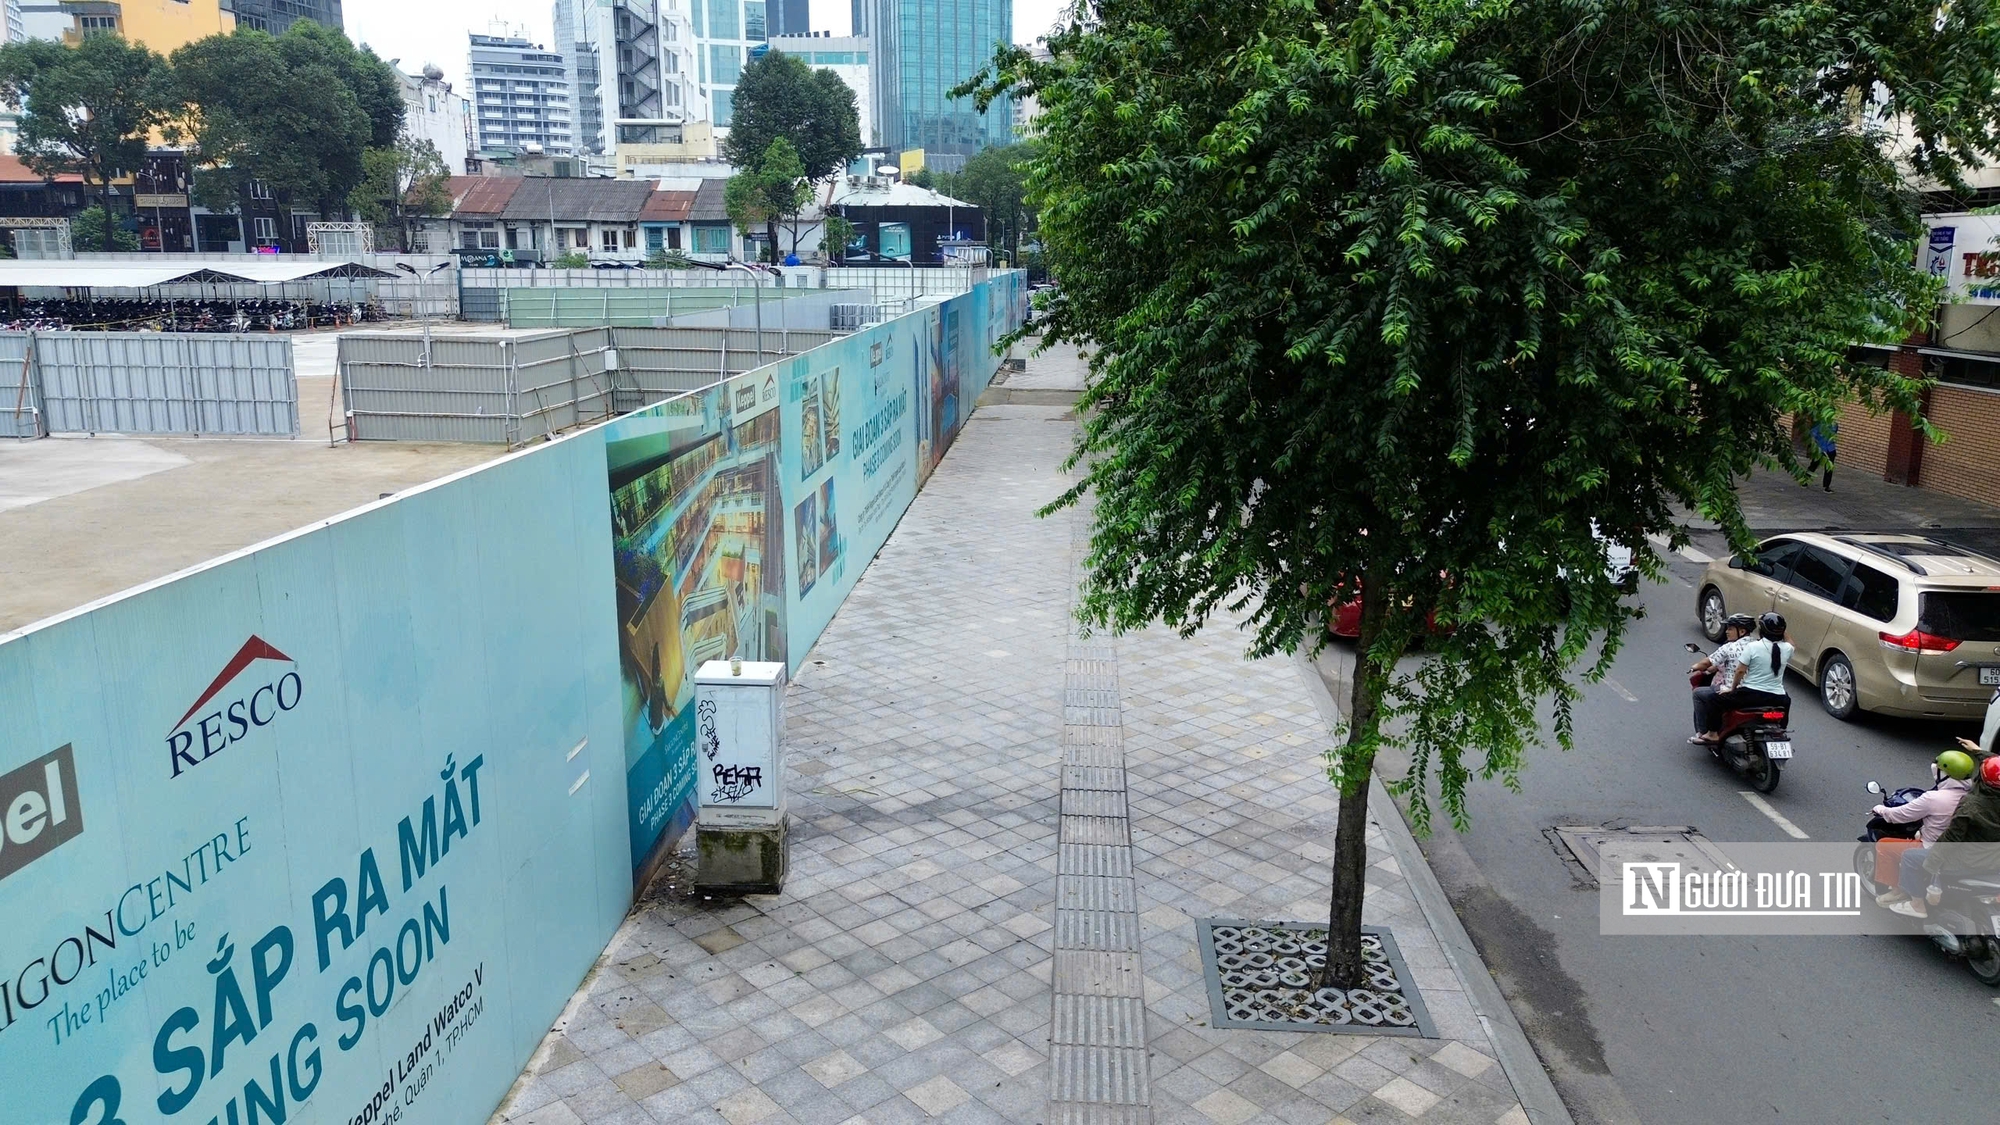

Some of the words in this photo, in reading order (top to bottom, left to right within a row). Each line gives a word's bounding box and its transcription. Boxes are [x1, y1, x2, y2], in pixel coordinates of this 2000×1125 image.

[165, 672, 302, 780] RESCO
[639, 794, 654, 825] GIAI
[654, 768, 673, 799] ĐOẠN
[673, 763, 678, 780] 3
[650, 798, 668, 831] PHASE
[669, 793, 672, 806] 3
[673, 768, 692, 800] COMING
[0, 816, 251, 1032] IGONCENTRE
[47, 1001, 91, 1045] The
[96, 958, 147, 1023] place
[151, 941, 171, 968] to
[174, 919, 196, 951] be
[153, 925, 294, 1116] SẮP
[312, 846, 390, 973] RA
[397, 752, 484, 894] MẮT
[336, 884, 450, 1051] SOON
[398, 1024, 432, 1084] Land
[434, 982, 473, 1038] Watco
[474, 962, 483, 987] V
[405, 1064, 433, 1106] Quận
[435, 1050, 445, 1066] 1,
[445, 996, 484, 1053] TP.HCM
